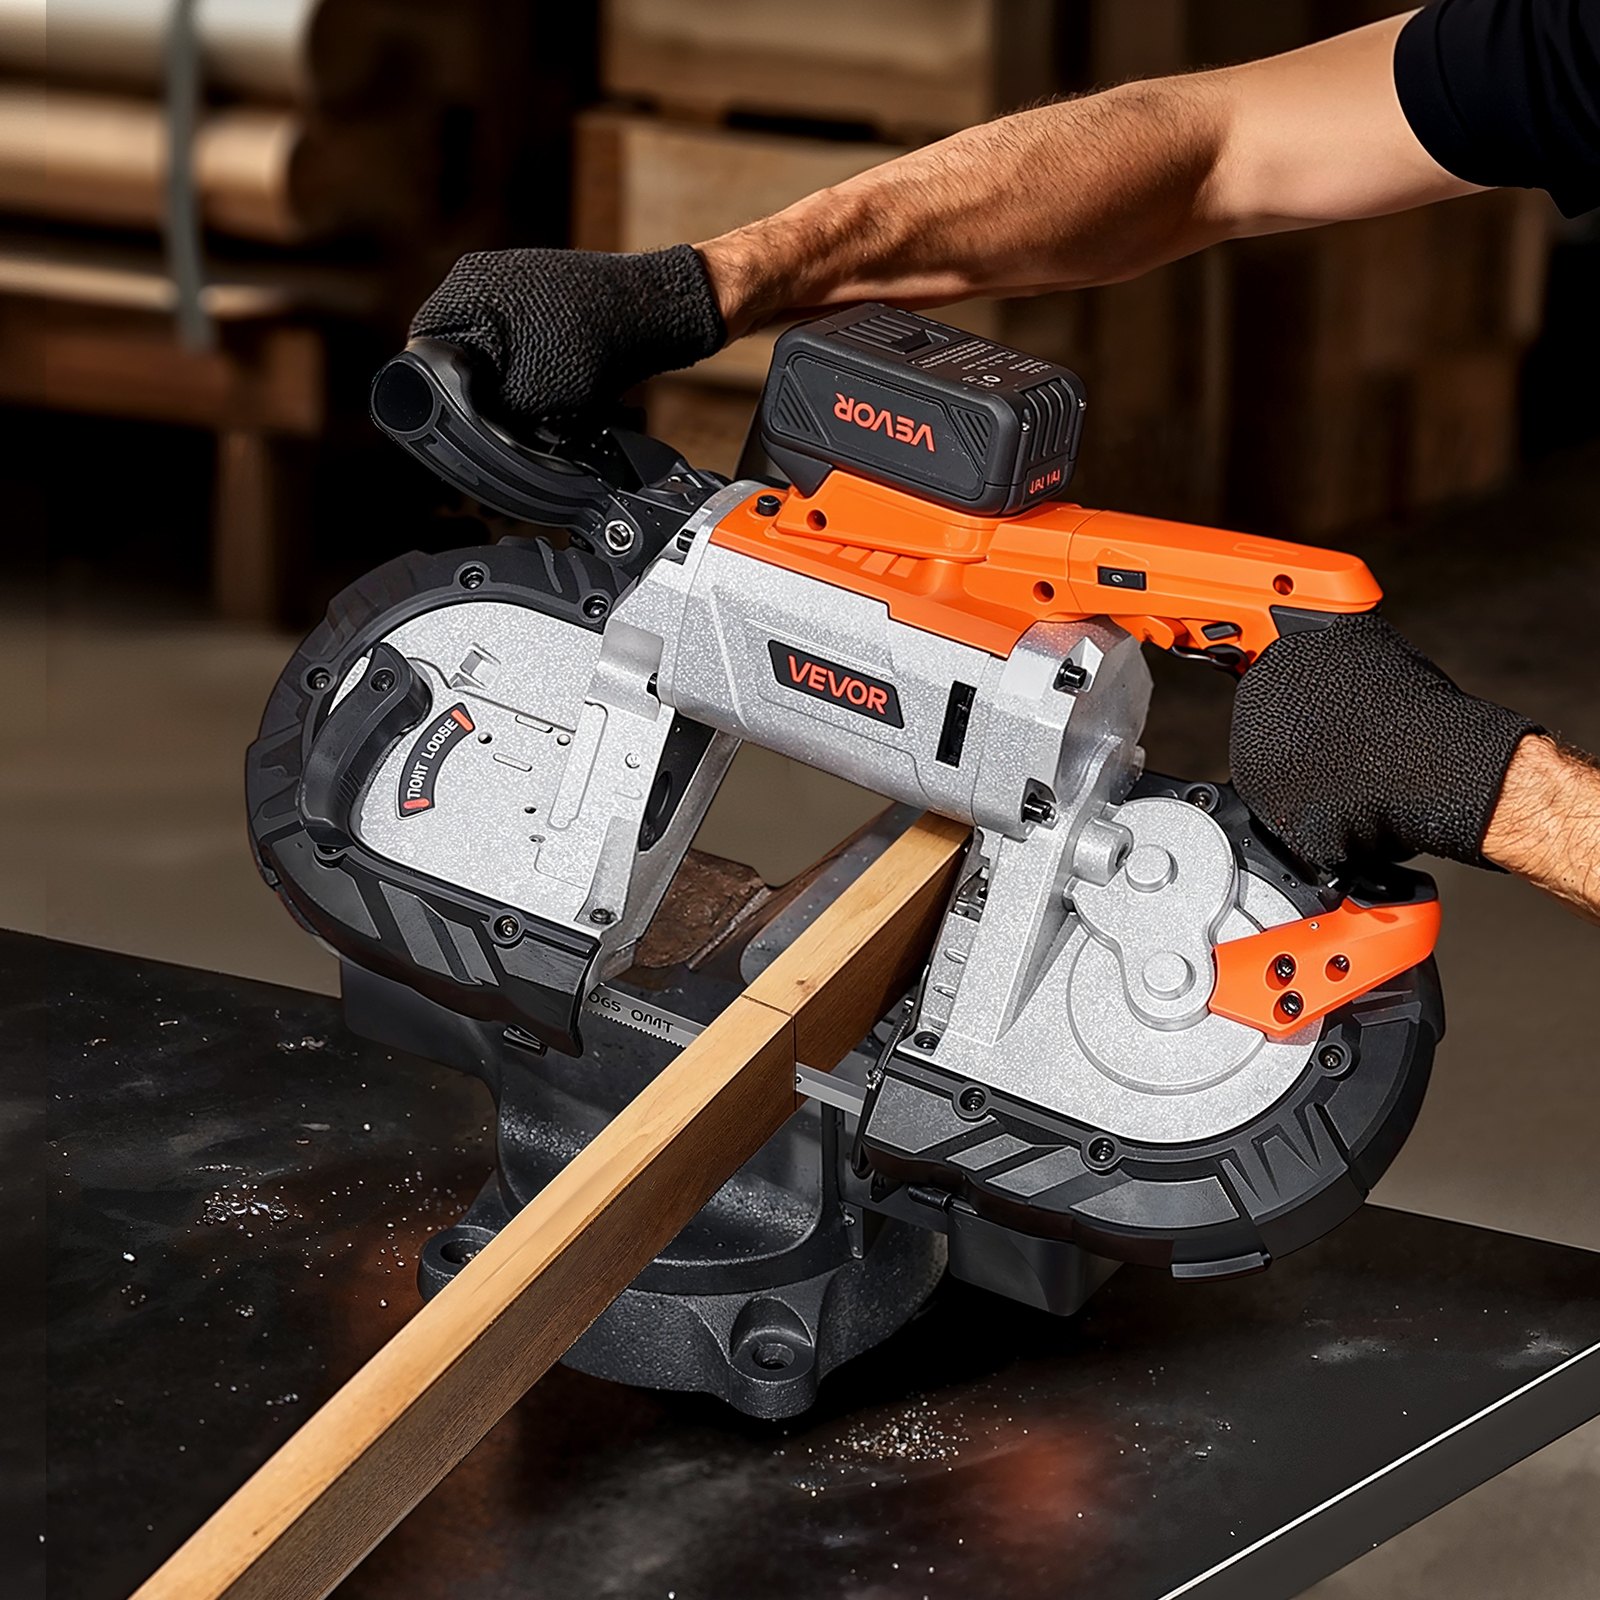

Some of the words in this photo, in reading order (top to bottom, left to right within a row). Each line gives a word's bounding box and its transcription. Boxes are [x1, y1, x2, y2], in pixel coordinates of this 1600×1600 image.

[833, 392, 935, 453] VEVOR
[788, 655, 888, 714] VEVOR
[421, 718, 459, 760] LOOSE
